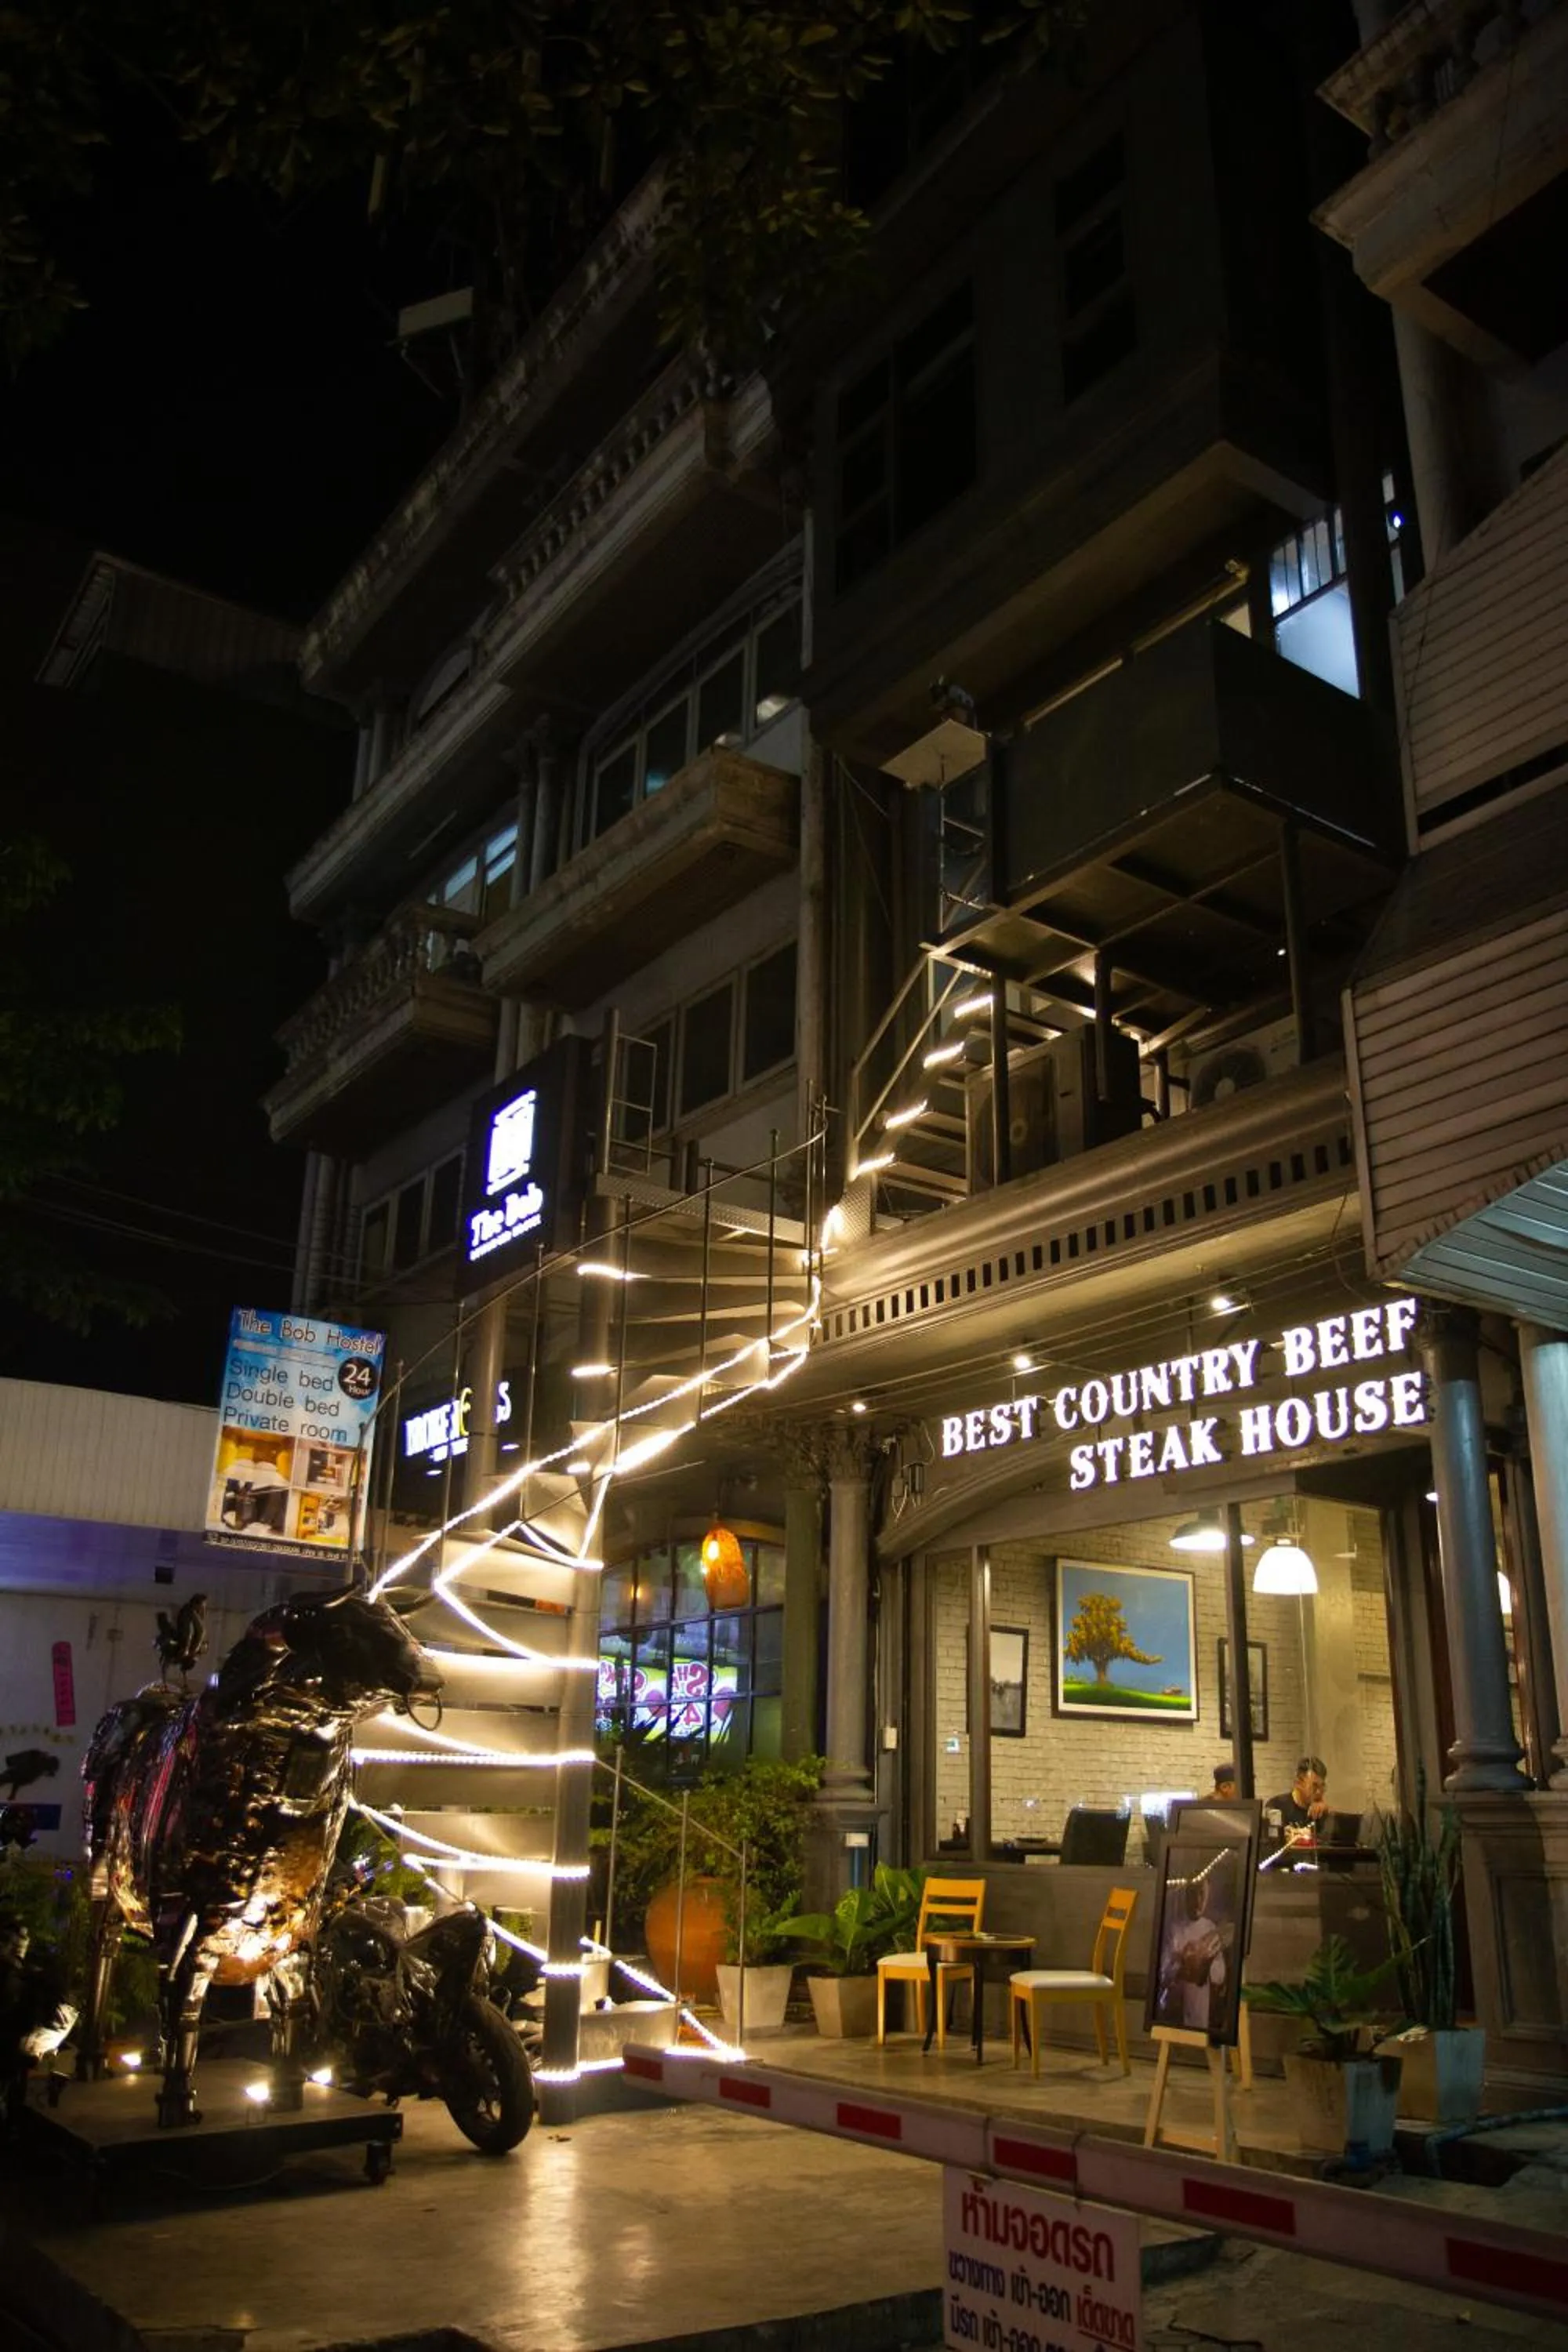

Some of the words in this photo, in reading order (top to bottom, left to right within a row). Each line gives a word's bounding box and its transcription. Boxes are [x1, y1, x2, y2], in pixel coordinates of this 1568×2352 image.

[238, 1308, 271, 1334] The
[281, 1319, 316, 1343] Bob
[326, 1329, 381, 1355] Hostel
[229, 1358, 289, 1385] Single
[299, 1370, 334, 1392] bed
[343, 1364, 372, 1385] 24
[942, 1395, 1040, 1457] BEST
[1054, 1339, 1261, 1431] COUNTRY
[1282, 1298, 1417, 1377] BEEF
[227, 1382, 294, 1409] Double
[305, 1395, 340, 1417] bed
[223, 1406, 289, 1432] Private
[300, 1421, 347, 1443] room
[1069, 1417, 1223, 1490] STEAK
[1239, 1371, 1428, 1456] HOUSE
[961, 2180, 1115, 2282] ห้ามจอดรถ
[949, 2249, 1005, 2298] ขวางทาง
[1011, 2264, 1072, 2322] เข้า-ออก
[1076, 2285, 1136, 2346] เด็ดขาด
